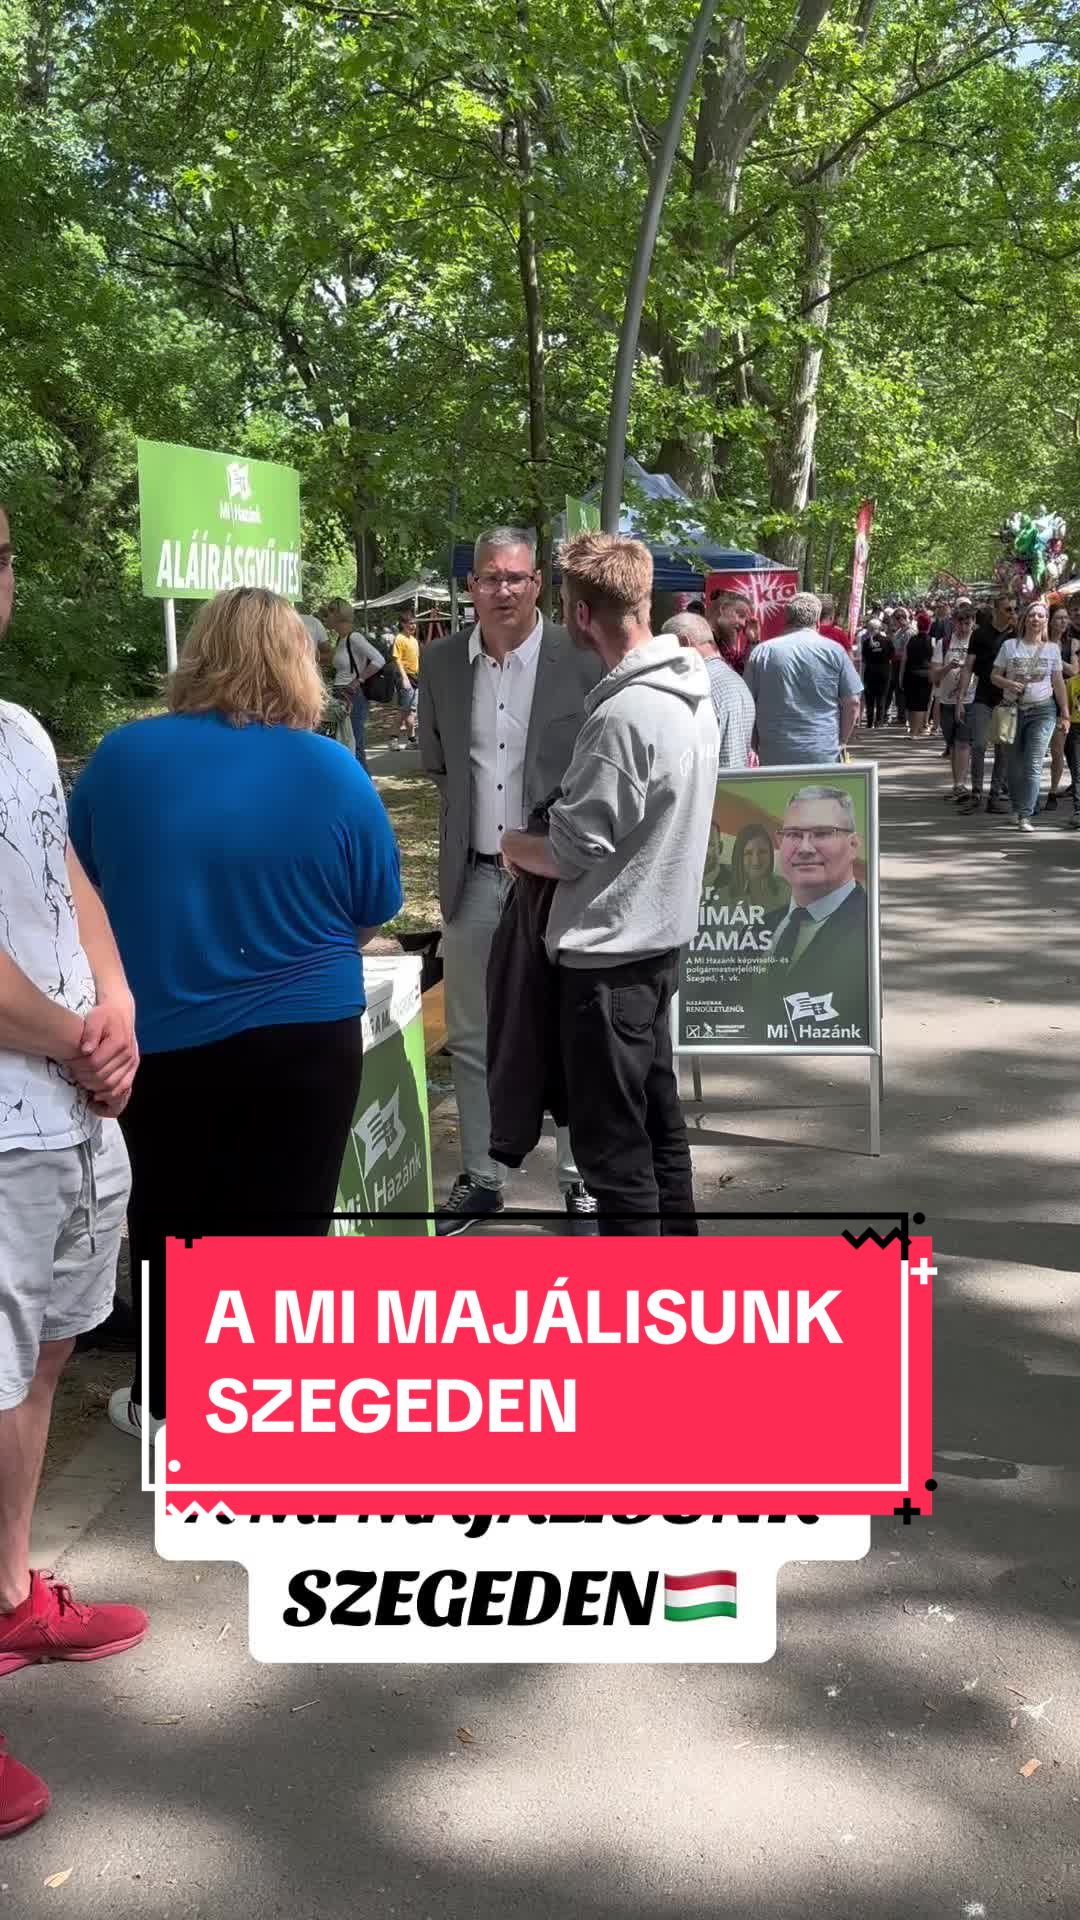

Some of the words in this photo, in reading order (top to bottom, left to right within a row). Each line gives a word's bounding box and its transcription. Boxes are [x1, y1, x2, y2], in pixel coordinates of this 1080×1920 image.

[698, 900, 765, 926] ÍMÁR
[767, 1024, 788, 1039] Mi
[799, 1023, 861, 1039] Hazánk
[373, 1143, 421, 1212] Hazánk
